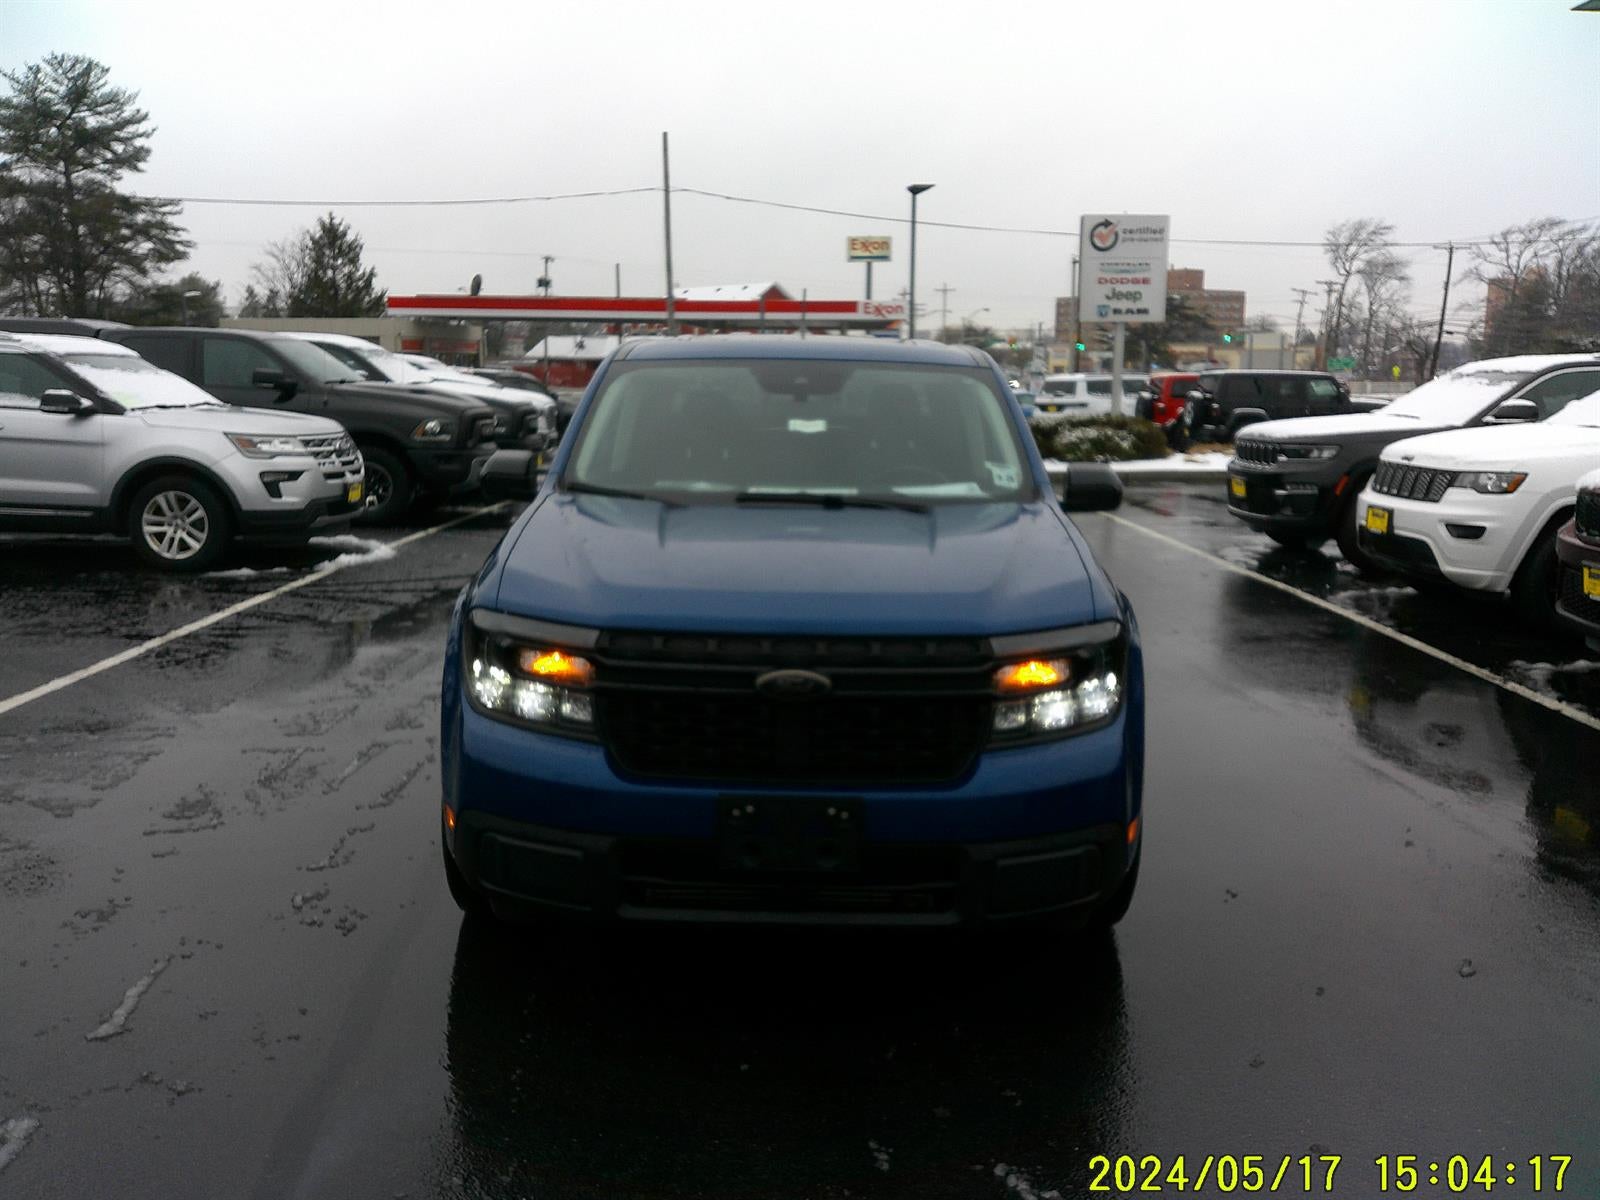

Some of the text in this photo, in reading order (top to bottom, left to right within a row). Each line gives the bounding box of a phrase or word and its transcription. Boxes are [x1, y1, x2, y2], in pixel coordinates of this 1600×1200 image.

[850, 238, 890, 254] Exxon
[1097, 277, 1151, 285] DODGE
[1105, 287, 1143, 303] Jeep
[863, 302, 905, 318] Exxon
[1112, 307, 1150, 315] RAM
